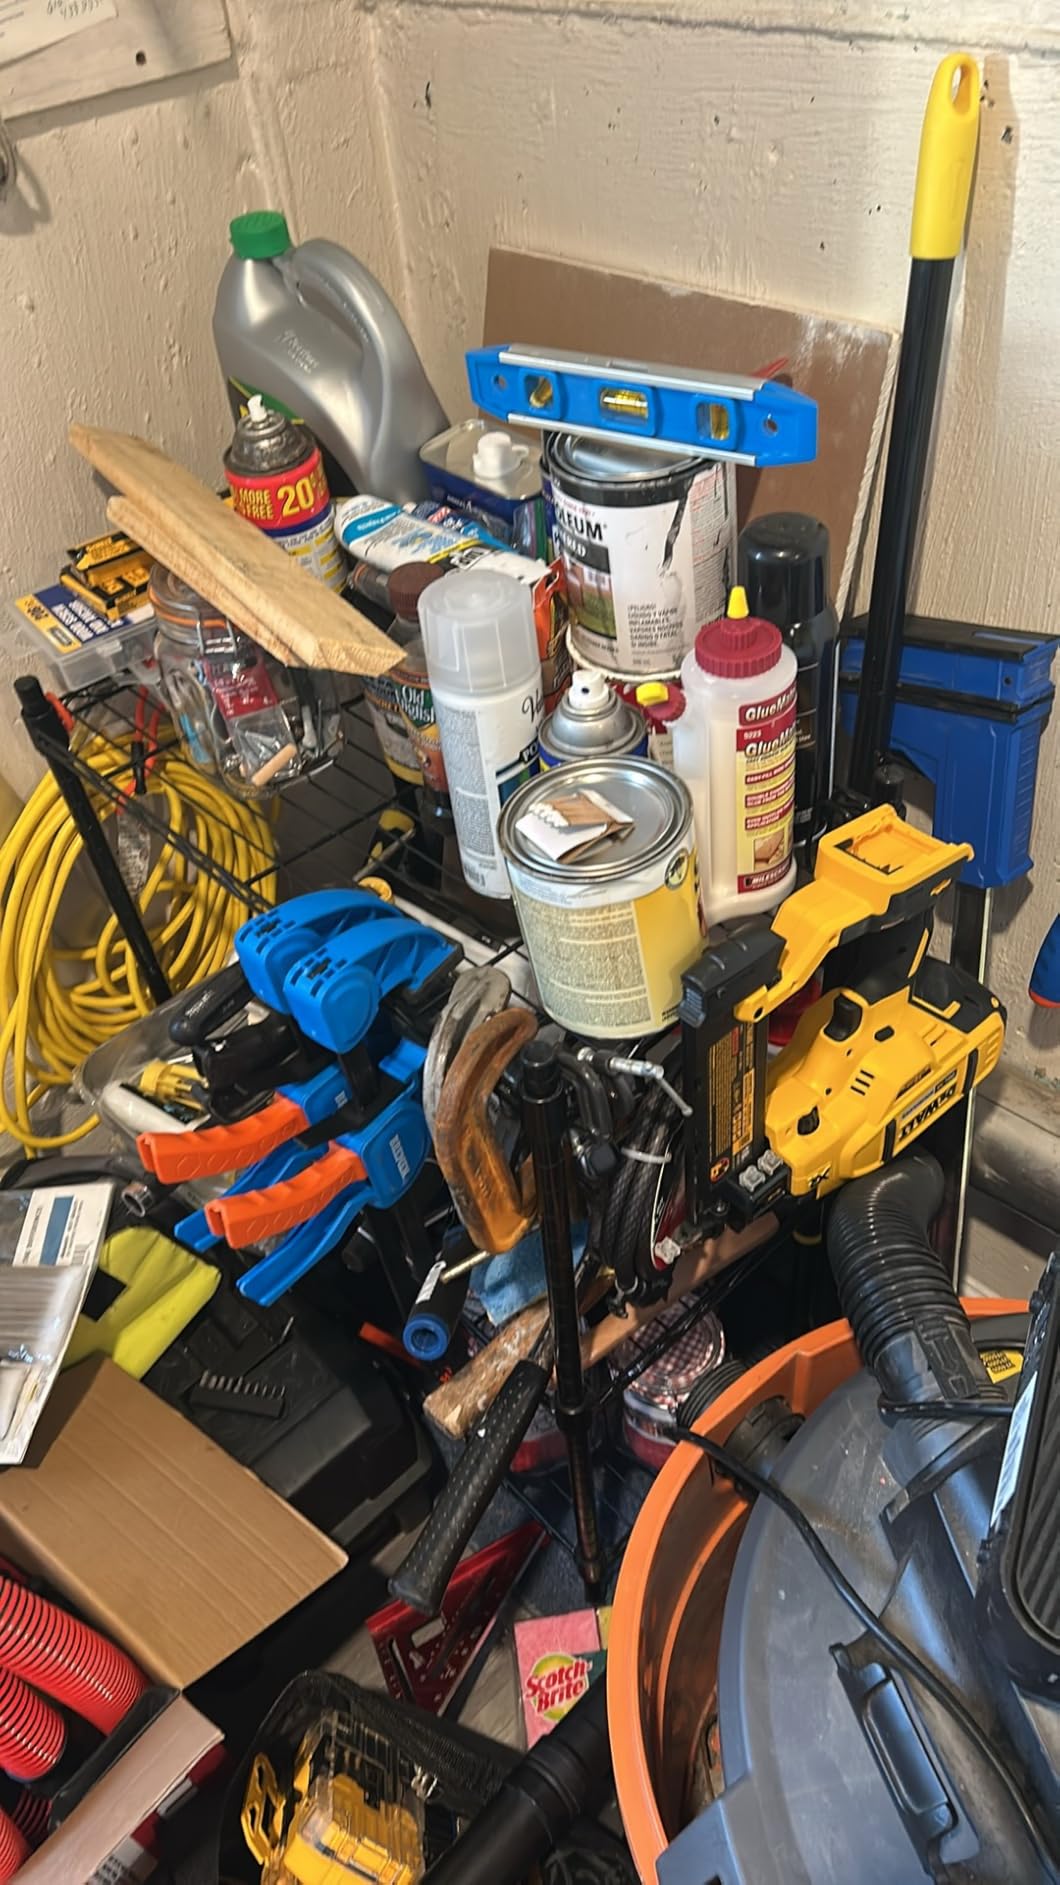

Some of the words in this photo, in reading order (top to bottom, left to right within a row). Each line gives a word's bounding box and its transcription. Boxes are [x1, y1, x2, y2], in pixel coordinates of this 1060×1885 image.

[239, 487, 271, 506] MORE
[244, 502, 275, 520] FREE
[900, 1083, 957, 1142] DEWALT
[537, 1680, 584, 1713] Brite
